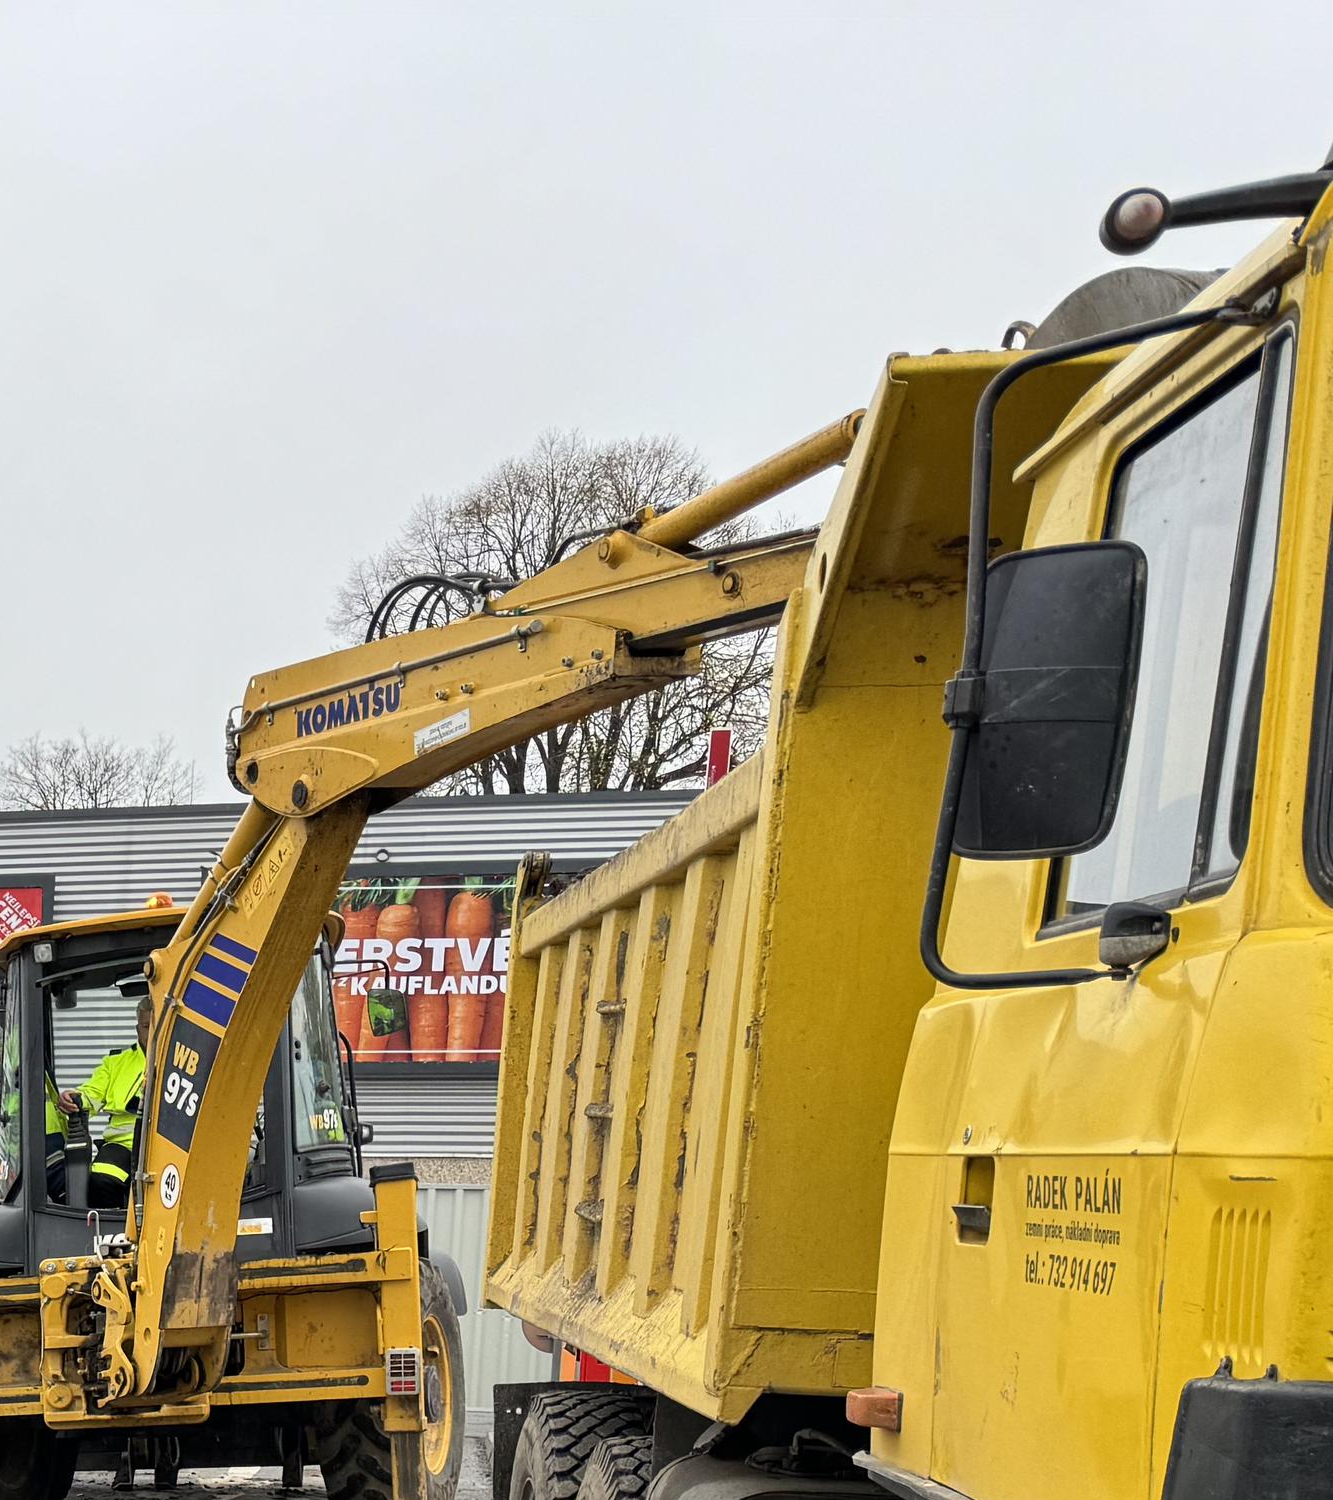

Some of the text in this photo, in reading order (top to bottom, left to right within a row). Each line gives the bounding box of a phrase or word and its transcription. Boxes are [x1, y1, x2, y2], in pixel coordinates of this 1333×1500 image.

[297, 682, 401, 737] KOMATSU
[172, 1041, 200, 1076] WB
[164, 1171, 176, 1192] 40
[1026, 1168, 1121, 1215] RADEK PALÁN
[1094, 1223, 1121, 1249] doprava
[1025, 1251, 1117, 1296] tel.: 732 914 697
